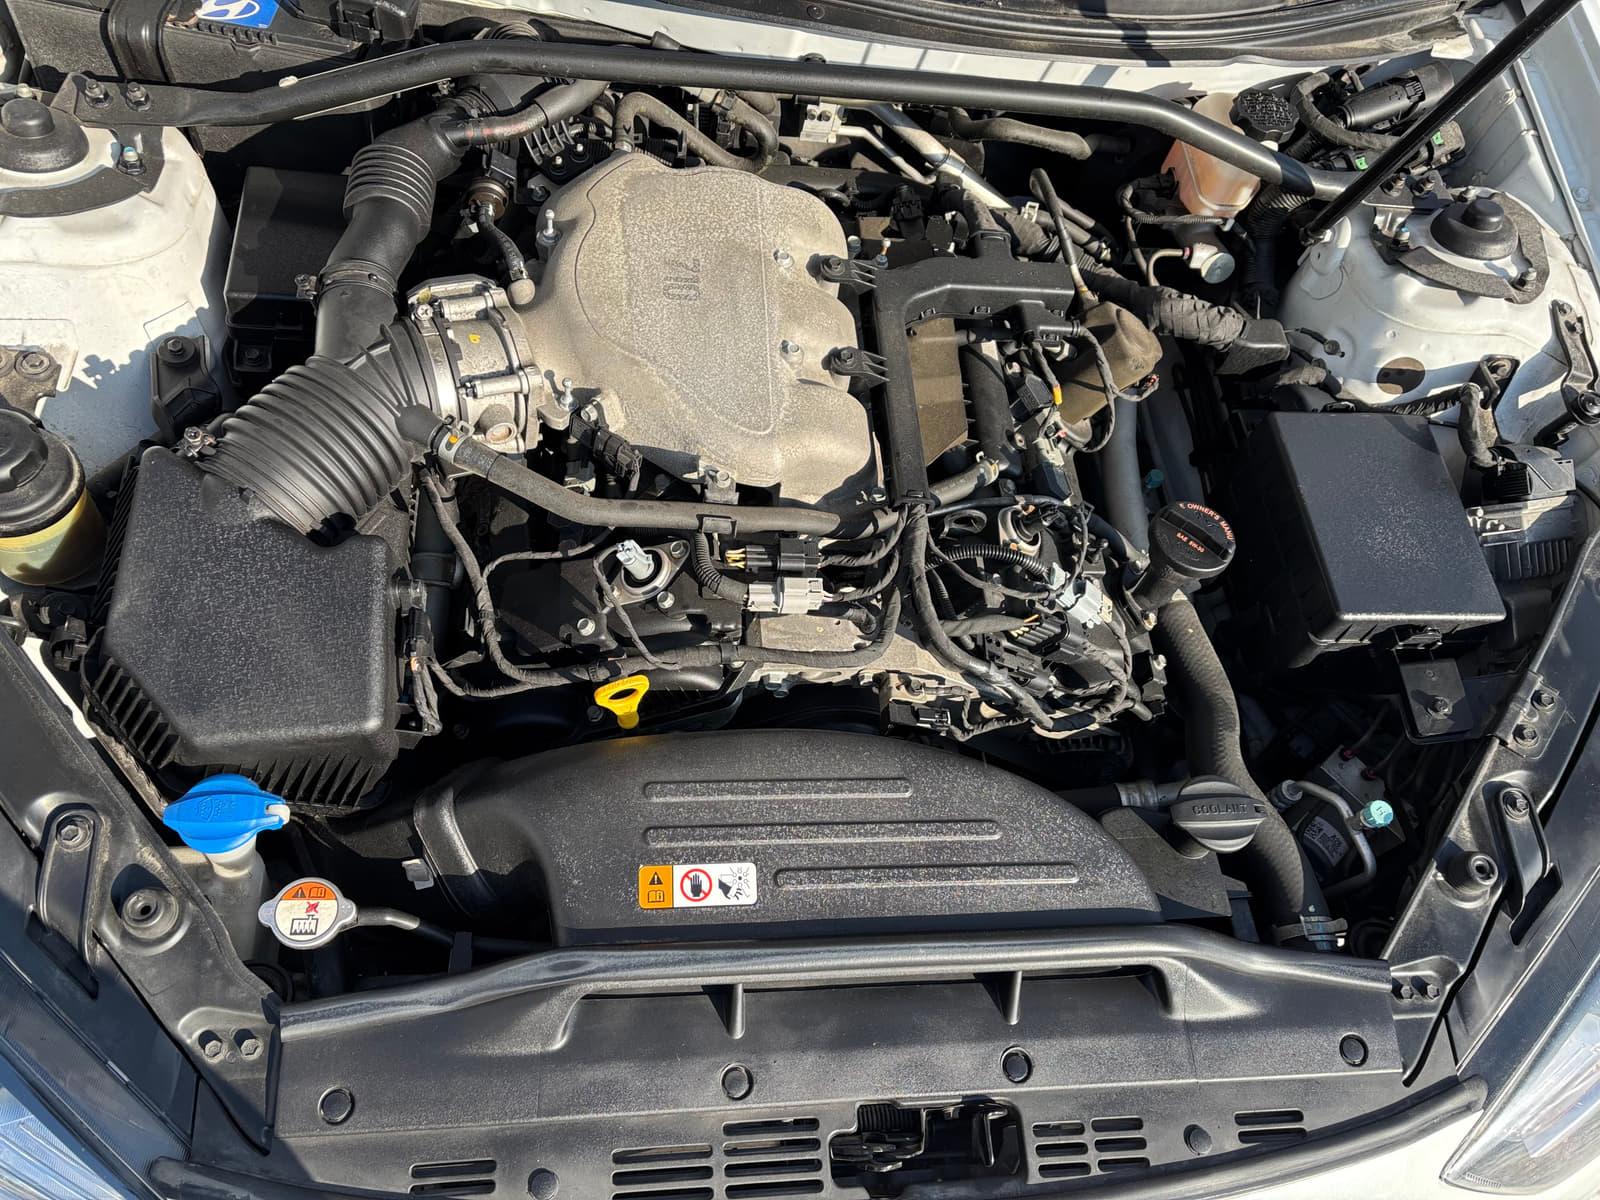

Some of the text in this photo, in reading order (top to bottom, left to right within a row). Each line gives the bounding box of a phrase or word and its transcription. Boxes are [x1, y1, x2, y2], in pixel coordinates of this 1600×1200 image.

[1187, 503, 1221, 521] OWNER'S
[1219, 520, 1235, 542] MANU
[1192, 803, 1247, 815] COOLANT
